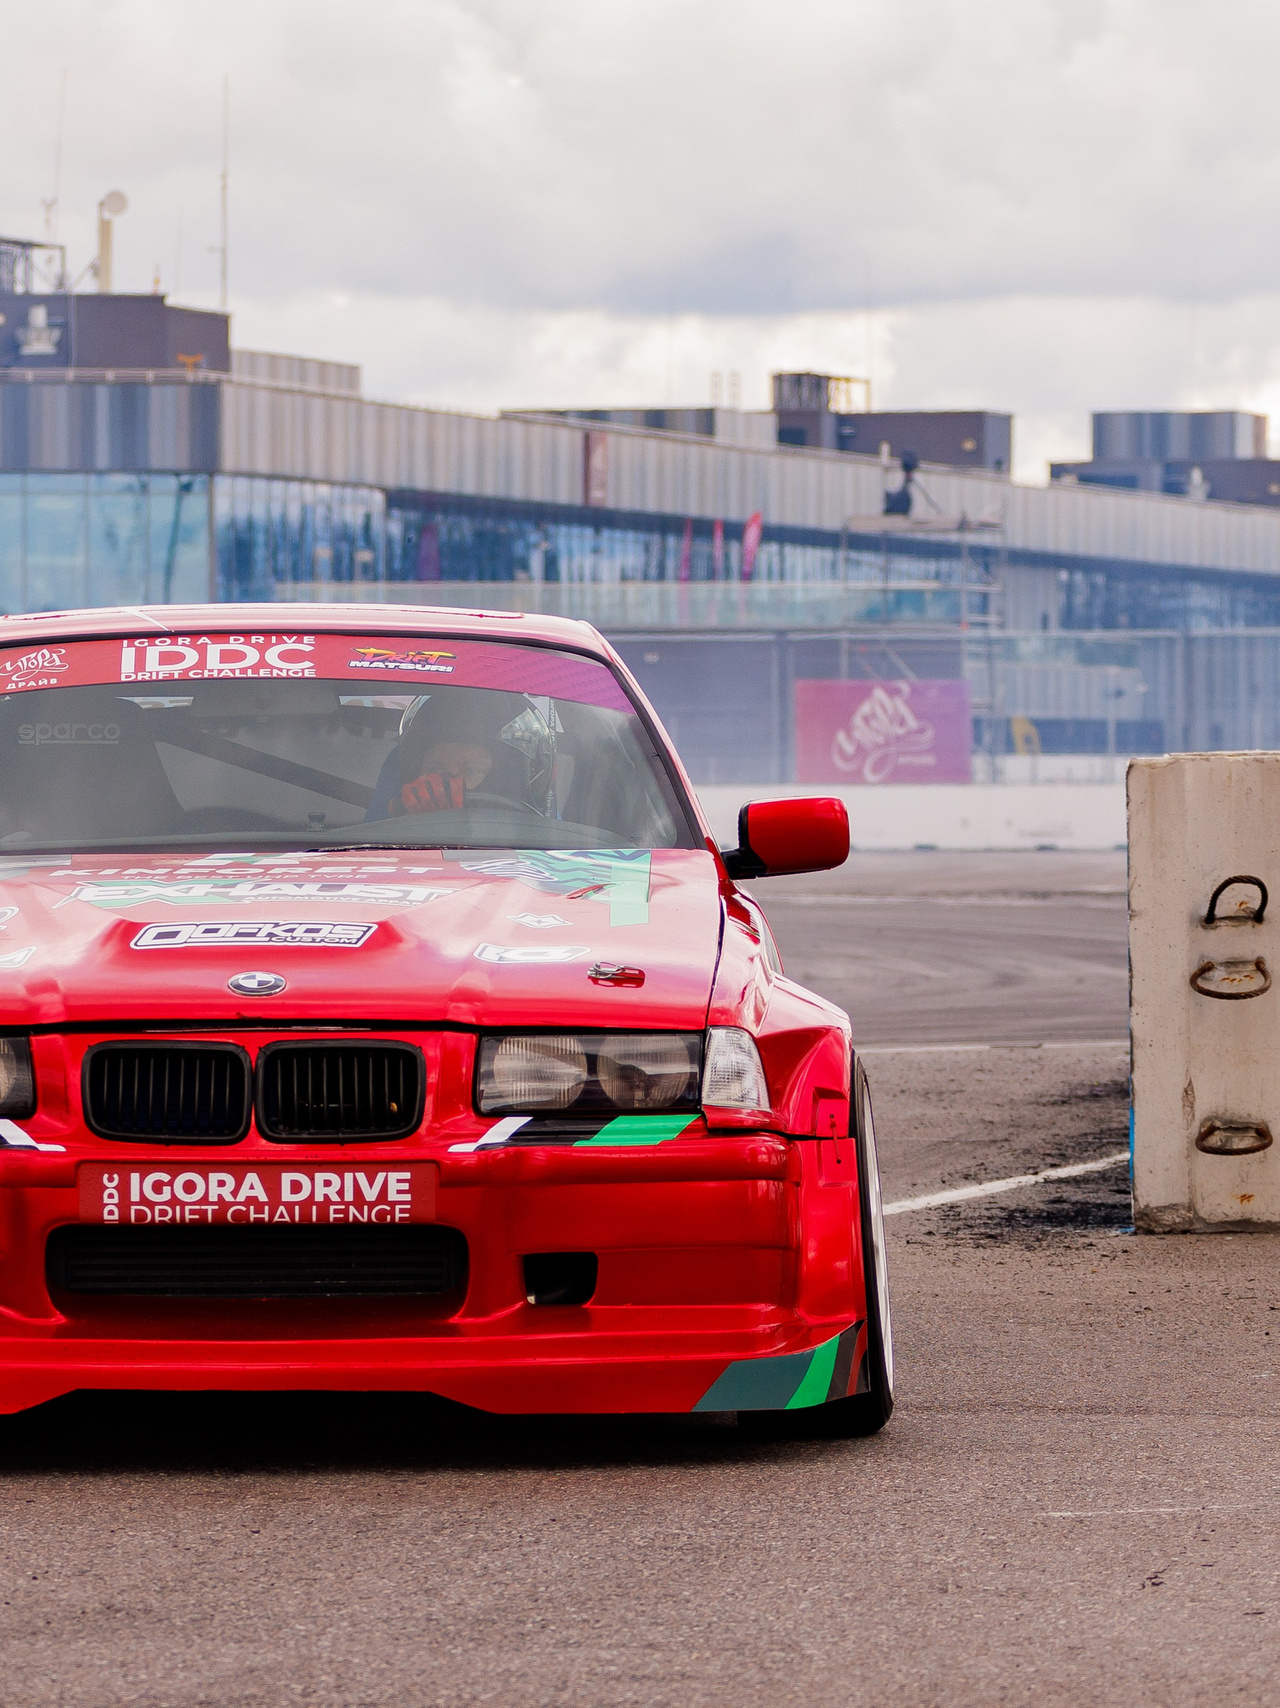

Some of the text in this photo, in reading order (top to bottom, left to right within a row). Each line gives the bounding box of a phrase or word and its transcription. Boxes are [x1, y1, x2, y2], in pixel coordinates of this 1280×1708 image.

[122, 635, 316, 648] IGORA DRIVE
[121, 643, 315, 673] IDDC
[349, 660, 454, 673] MATSURI
[120, 668, 317, 682] DRIFT CHALLENGE
[5, 677, 58, 690] ДРАЙВ
[17, 722, 121, 746] sparco
[49, 866, 445, 877] KINFOREST
[72, 880, 455, 906] EXHAUST
[271, 936, 357, 944] CUSTOM
[130, 1171, 412, 1202] IGORA DRIVE
[130, 1204, 412, 1224] DRIFT CHALLENGE
